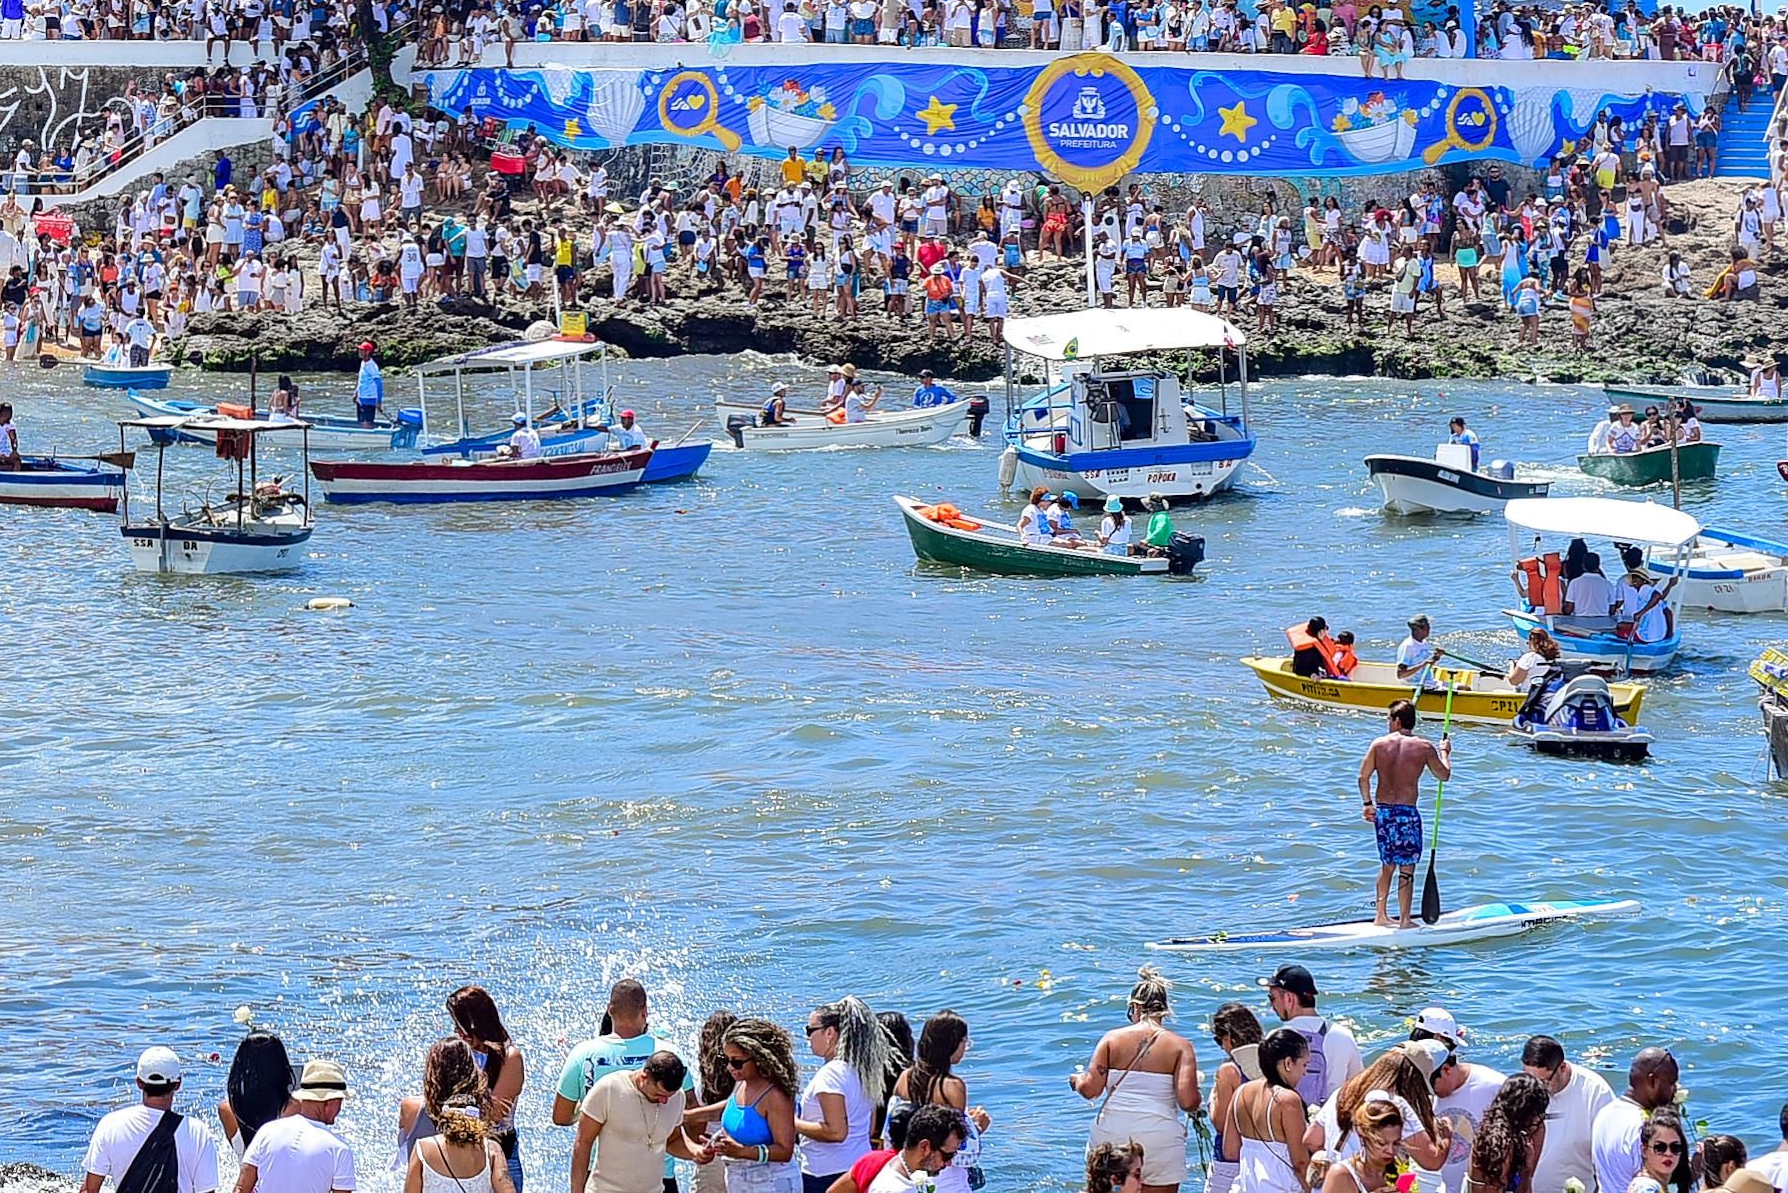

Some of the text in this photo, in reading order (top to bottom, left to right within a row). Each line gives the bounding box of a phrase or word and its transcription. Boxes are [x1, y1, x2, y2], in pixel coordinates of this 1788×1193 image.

[1049, 123, 1129, 138] SALVADOR
[1060, 140, 1117, 148] PREFEITURA
[133, 538, 154, 548] SSA
